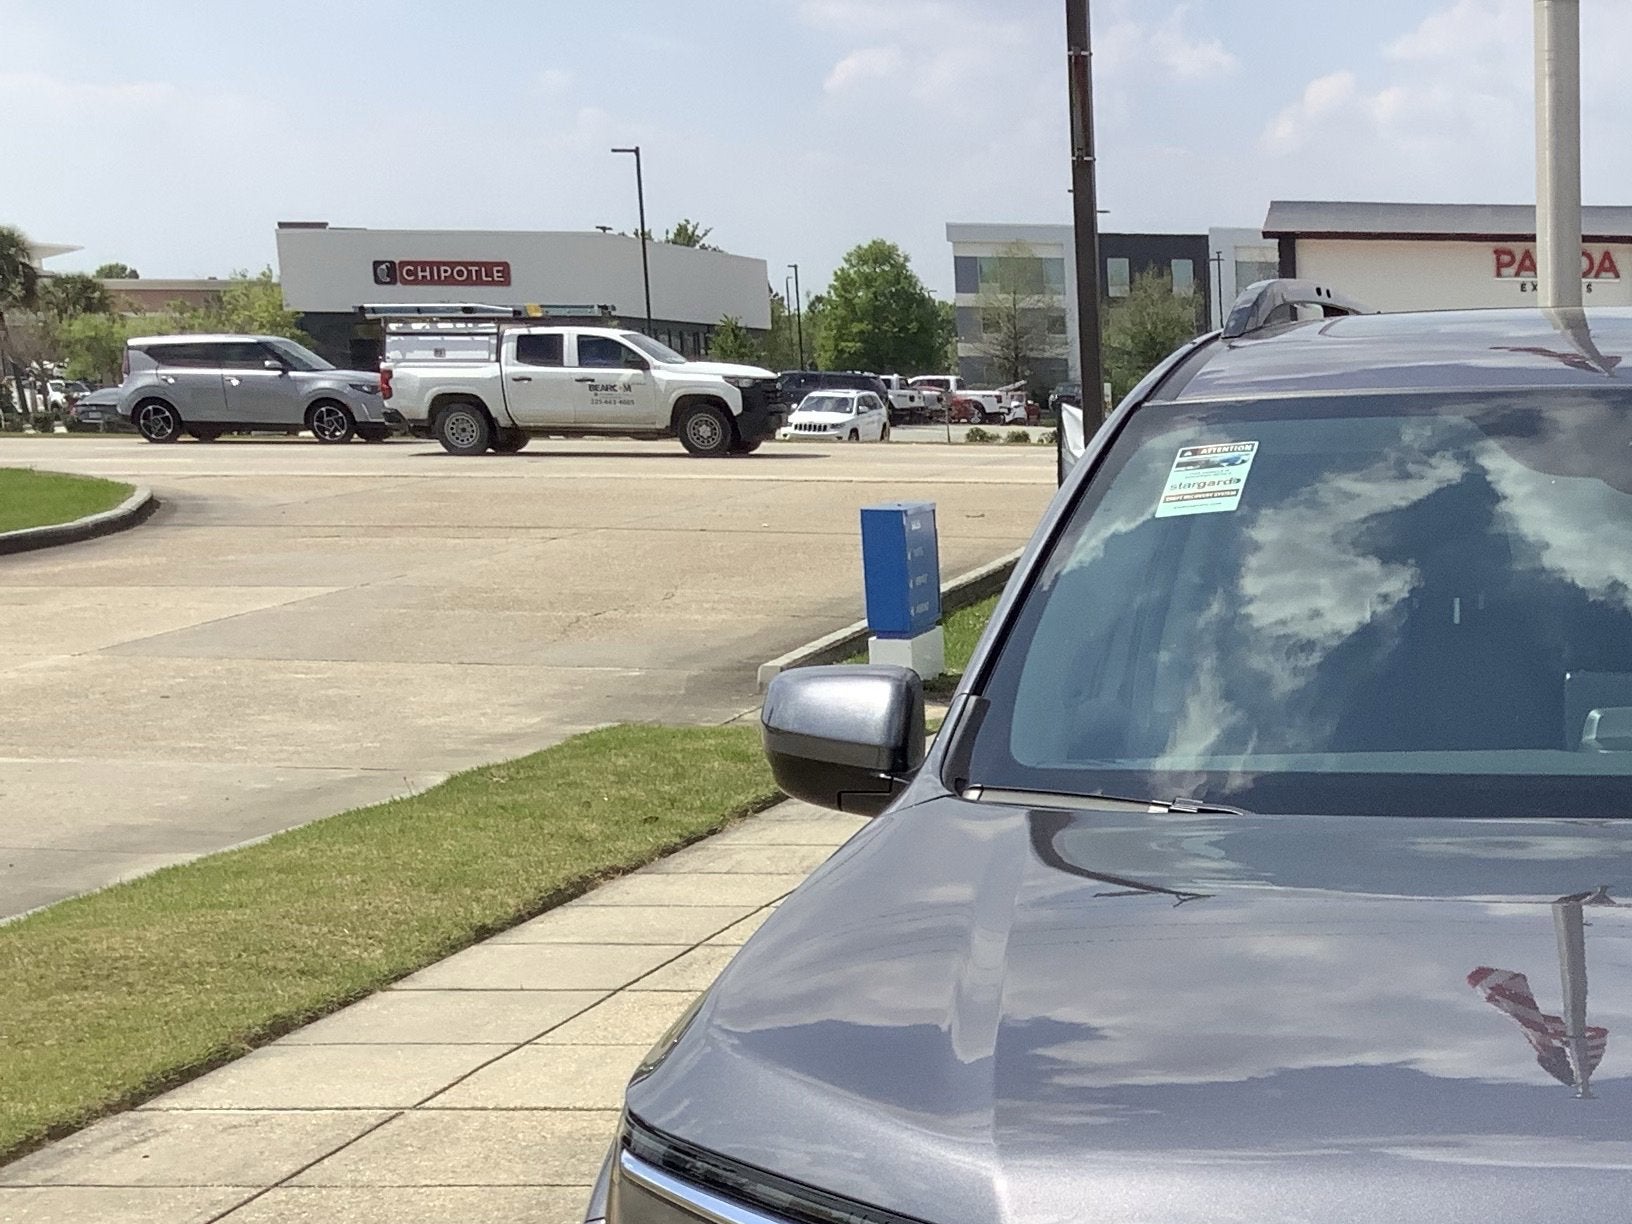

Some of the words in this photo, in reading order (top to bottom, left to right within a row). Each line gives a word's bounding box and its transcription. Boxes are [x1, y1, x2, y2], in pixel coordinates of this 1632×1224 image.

[1493, 248, 1620, 279] PADA
[402, 265, 505, 281] CHIPOTLE
[1200, 443, 1253, 455] ATTENTION
